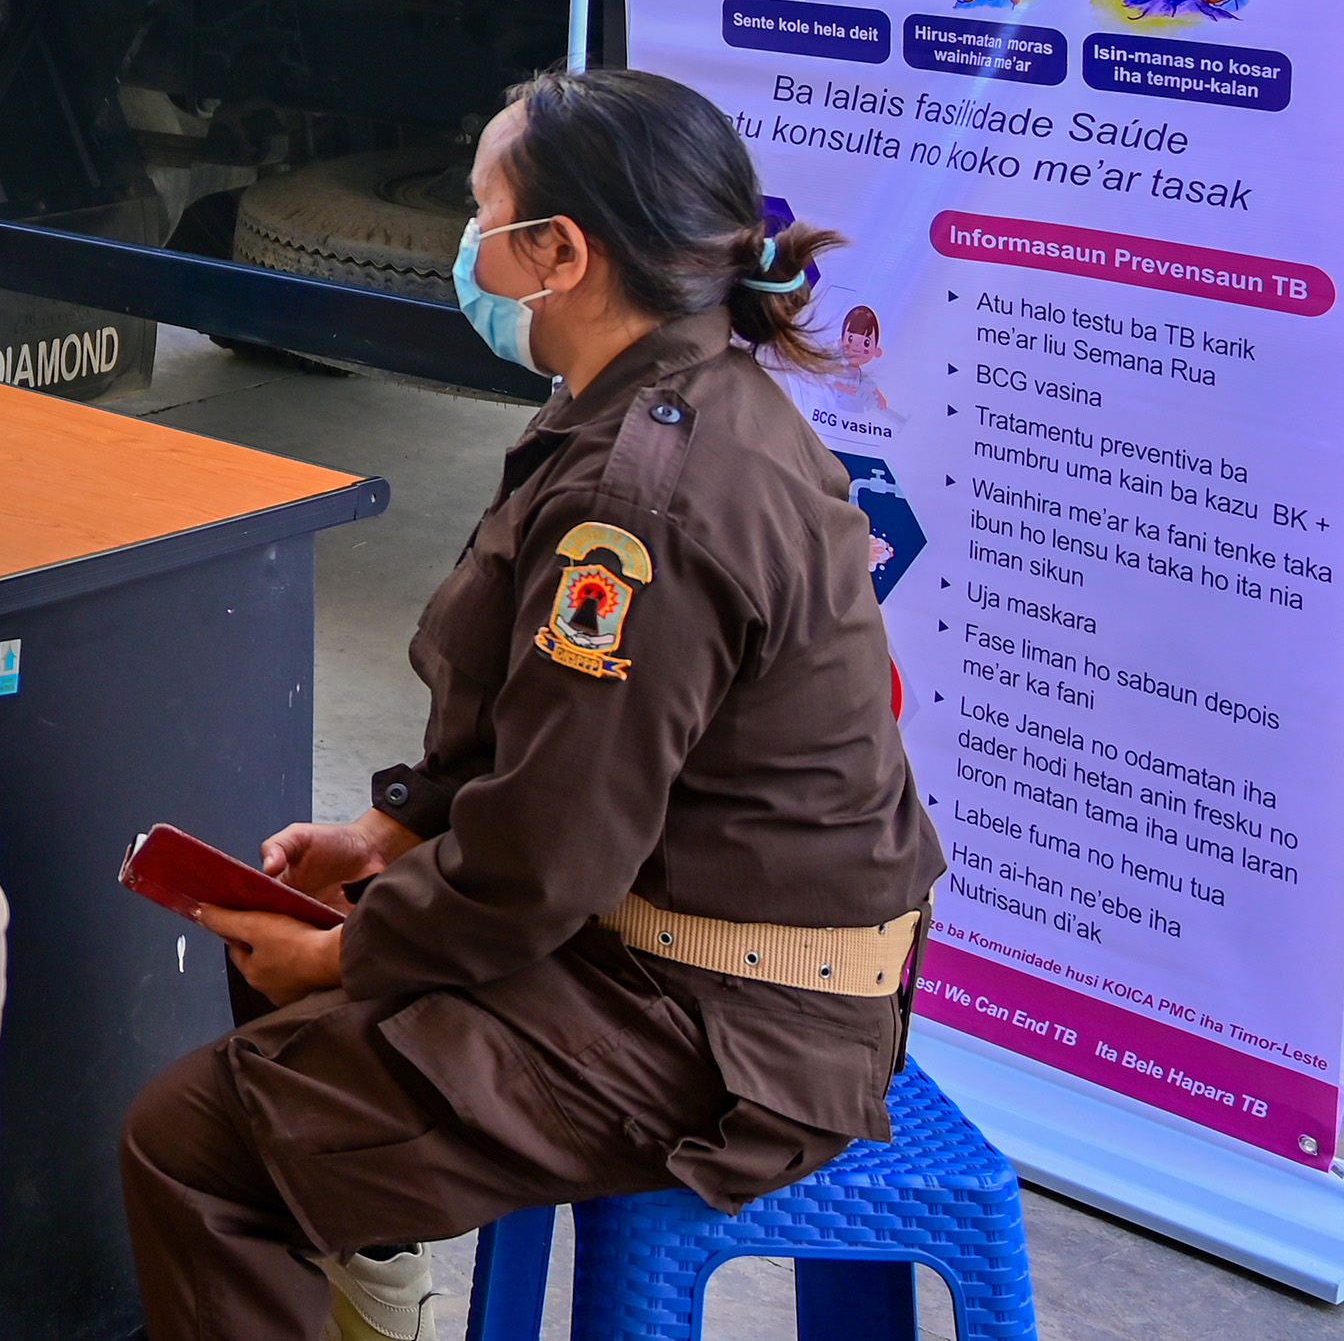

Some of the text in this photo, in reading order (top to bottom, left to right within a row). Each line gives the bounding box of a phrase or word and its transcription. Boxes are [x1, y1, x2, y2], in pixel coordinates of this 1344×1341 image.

[733, 13, 878, 42] Sente kole hela deit
[915, 26, 1053, 55] Hirus-matan moras
[935, 48, 992, 68] wainhira
[1094, 45, 1280, 79] Isin-manas no kosar
[1114, 66, 1259, 98] iha tempu-kalan
[773, 75, 1188, 154] Ba lalais fasilidade Saúde
[772, 115, 900, 159] konsulta
[911, 141, 940, 165] no
[947, 141, 1020, 178] koko
[1151, 168, 1252, 211] tasak
[950, 226, 1308, 301] Informasaun Prevensaun TB
[977, 292, 1256, 361] Atu halo testu ba TB karik
[1043, 332, 1066, 355] liu
[1073, 339, 1163, 376] Semana
[1170, 358, 1215, 386] Rua
[976, 365, 1102, 408] BCG vasina
[812, 408, 892, 439] BCG vasina
[972, 477, 1062, 517] Wainhira
[1135, 515, 1160, 540] ka
[1167, 524, 1207, 553] fani
[1215, 542, 1276, 569] tenke
[1283, 555, 1332, 583] taka
[967, 581, 1096, 634] Uja maskara
[965, 623, 1280, 730] Fase liman ho sabaun depois
[960, 696, 1277, 809] Loke Janela no odamatan iha
[954, 799, 1225, 906] Labele fuma no hemu tua
[950, 874, 1046, 924] Nutrisaun
[952, 843, 992, 873] Han
[999, 857, 1063, 896] ai-han
[1149, 908, 1181, 938] iha
[945, 984, 1077, 1047] We Can End TB
[947, 923, 1328, 1071] ba Komunidade husi KOICA PMC iha Timor-Leste
[1095, 1040, 1268, 1119] Ita Bele Hapara TB
